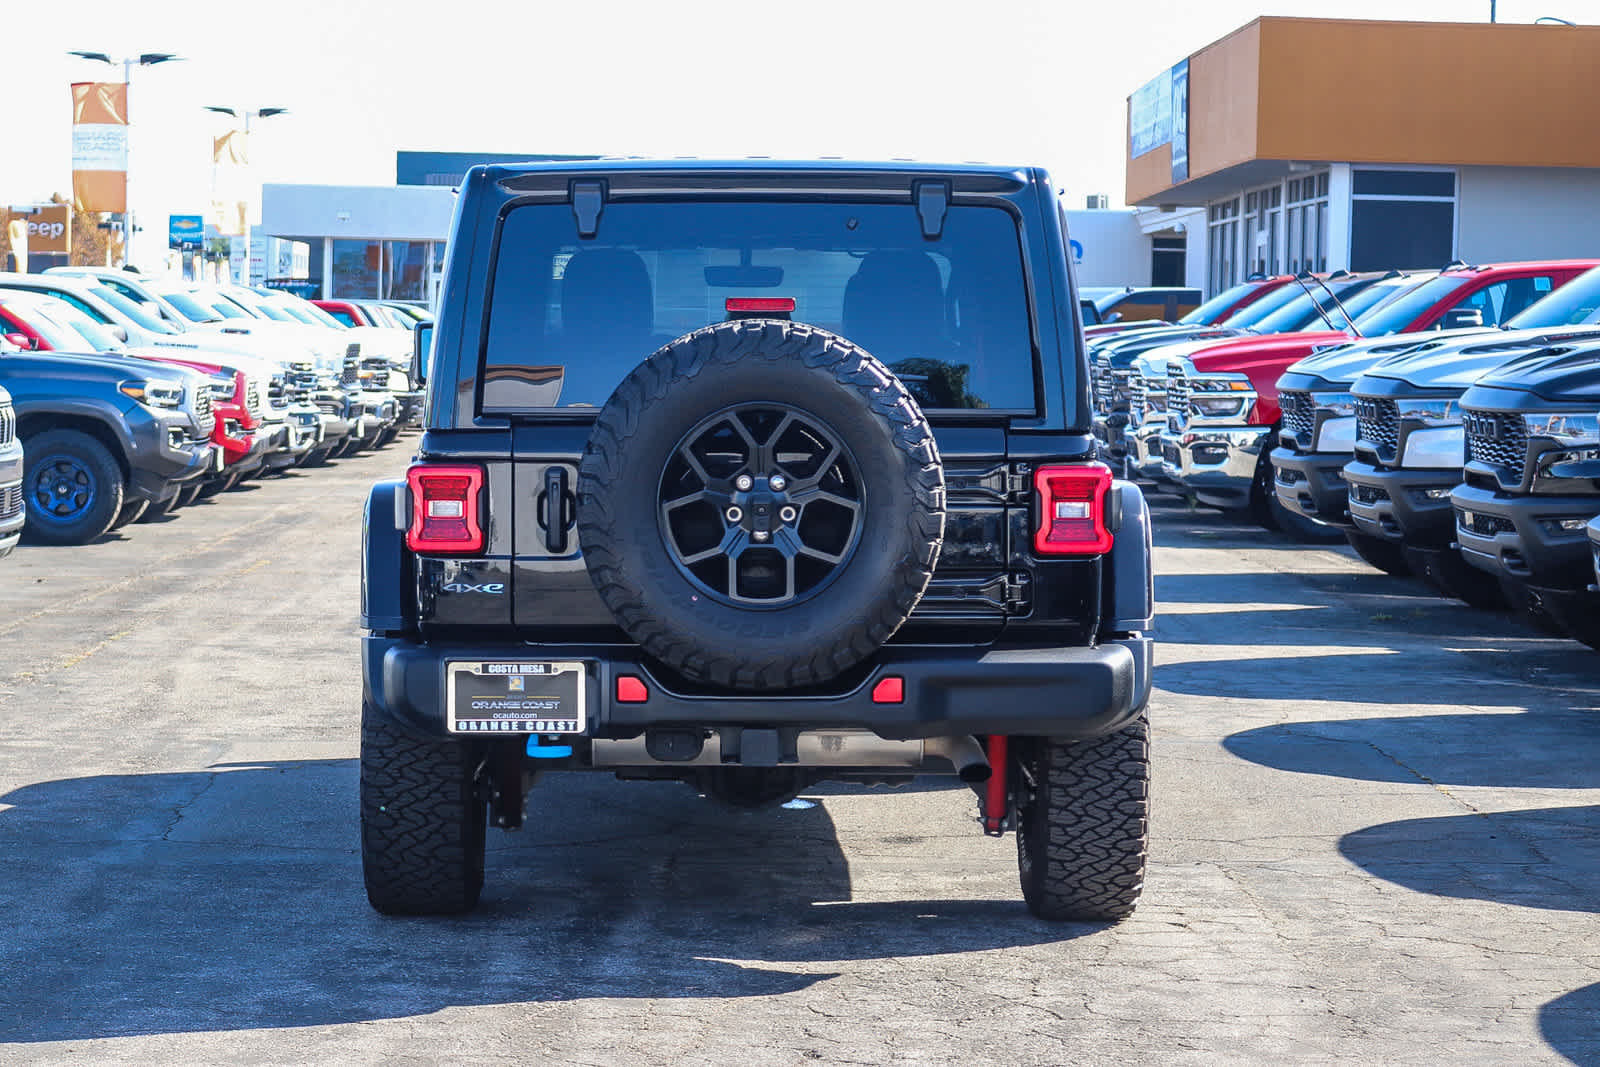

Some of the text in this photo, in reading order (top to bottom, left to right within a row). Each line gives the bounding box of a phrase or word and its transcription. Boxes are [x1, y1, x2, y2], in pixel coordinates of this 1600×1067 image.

[28, 222, 64, 240] eep
[488, 664, 545, 673] COSTA MESA
[471, 701, 560, 709] ORANGE COAST
[492, 711, 538, 719] ocauto.com
[458, 721, 575, 730] ORANGE COAST
